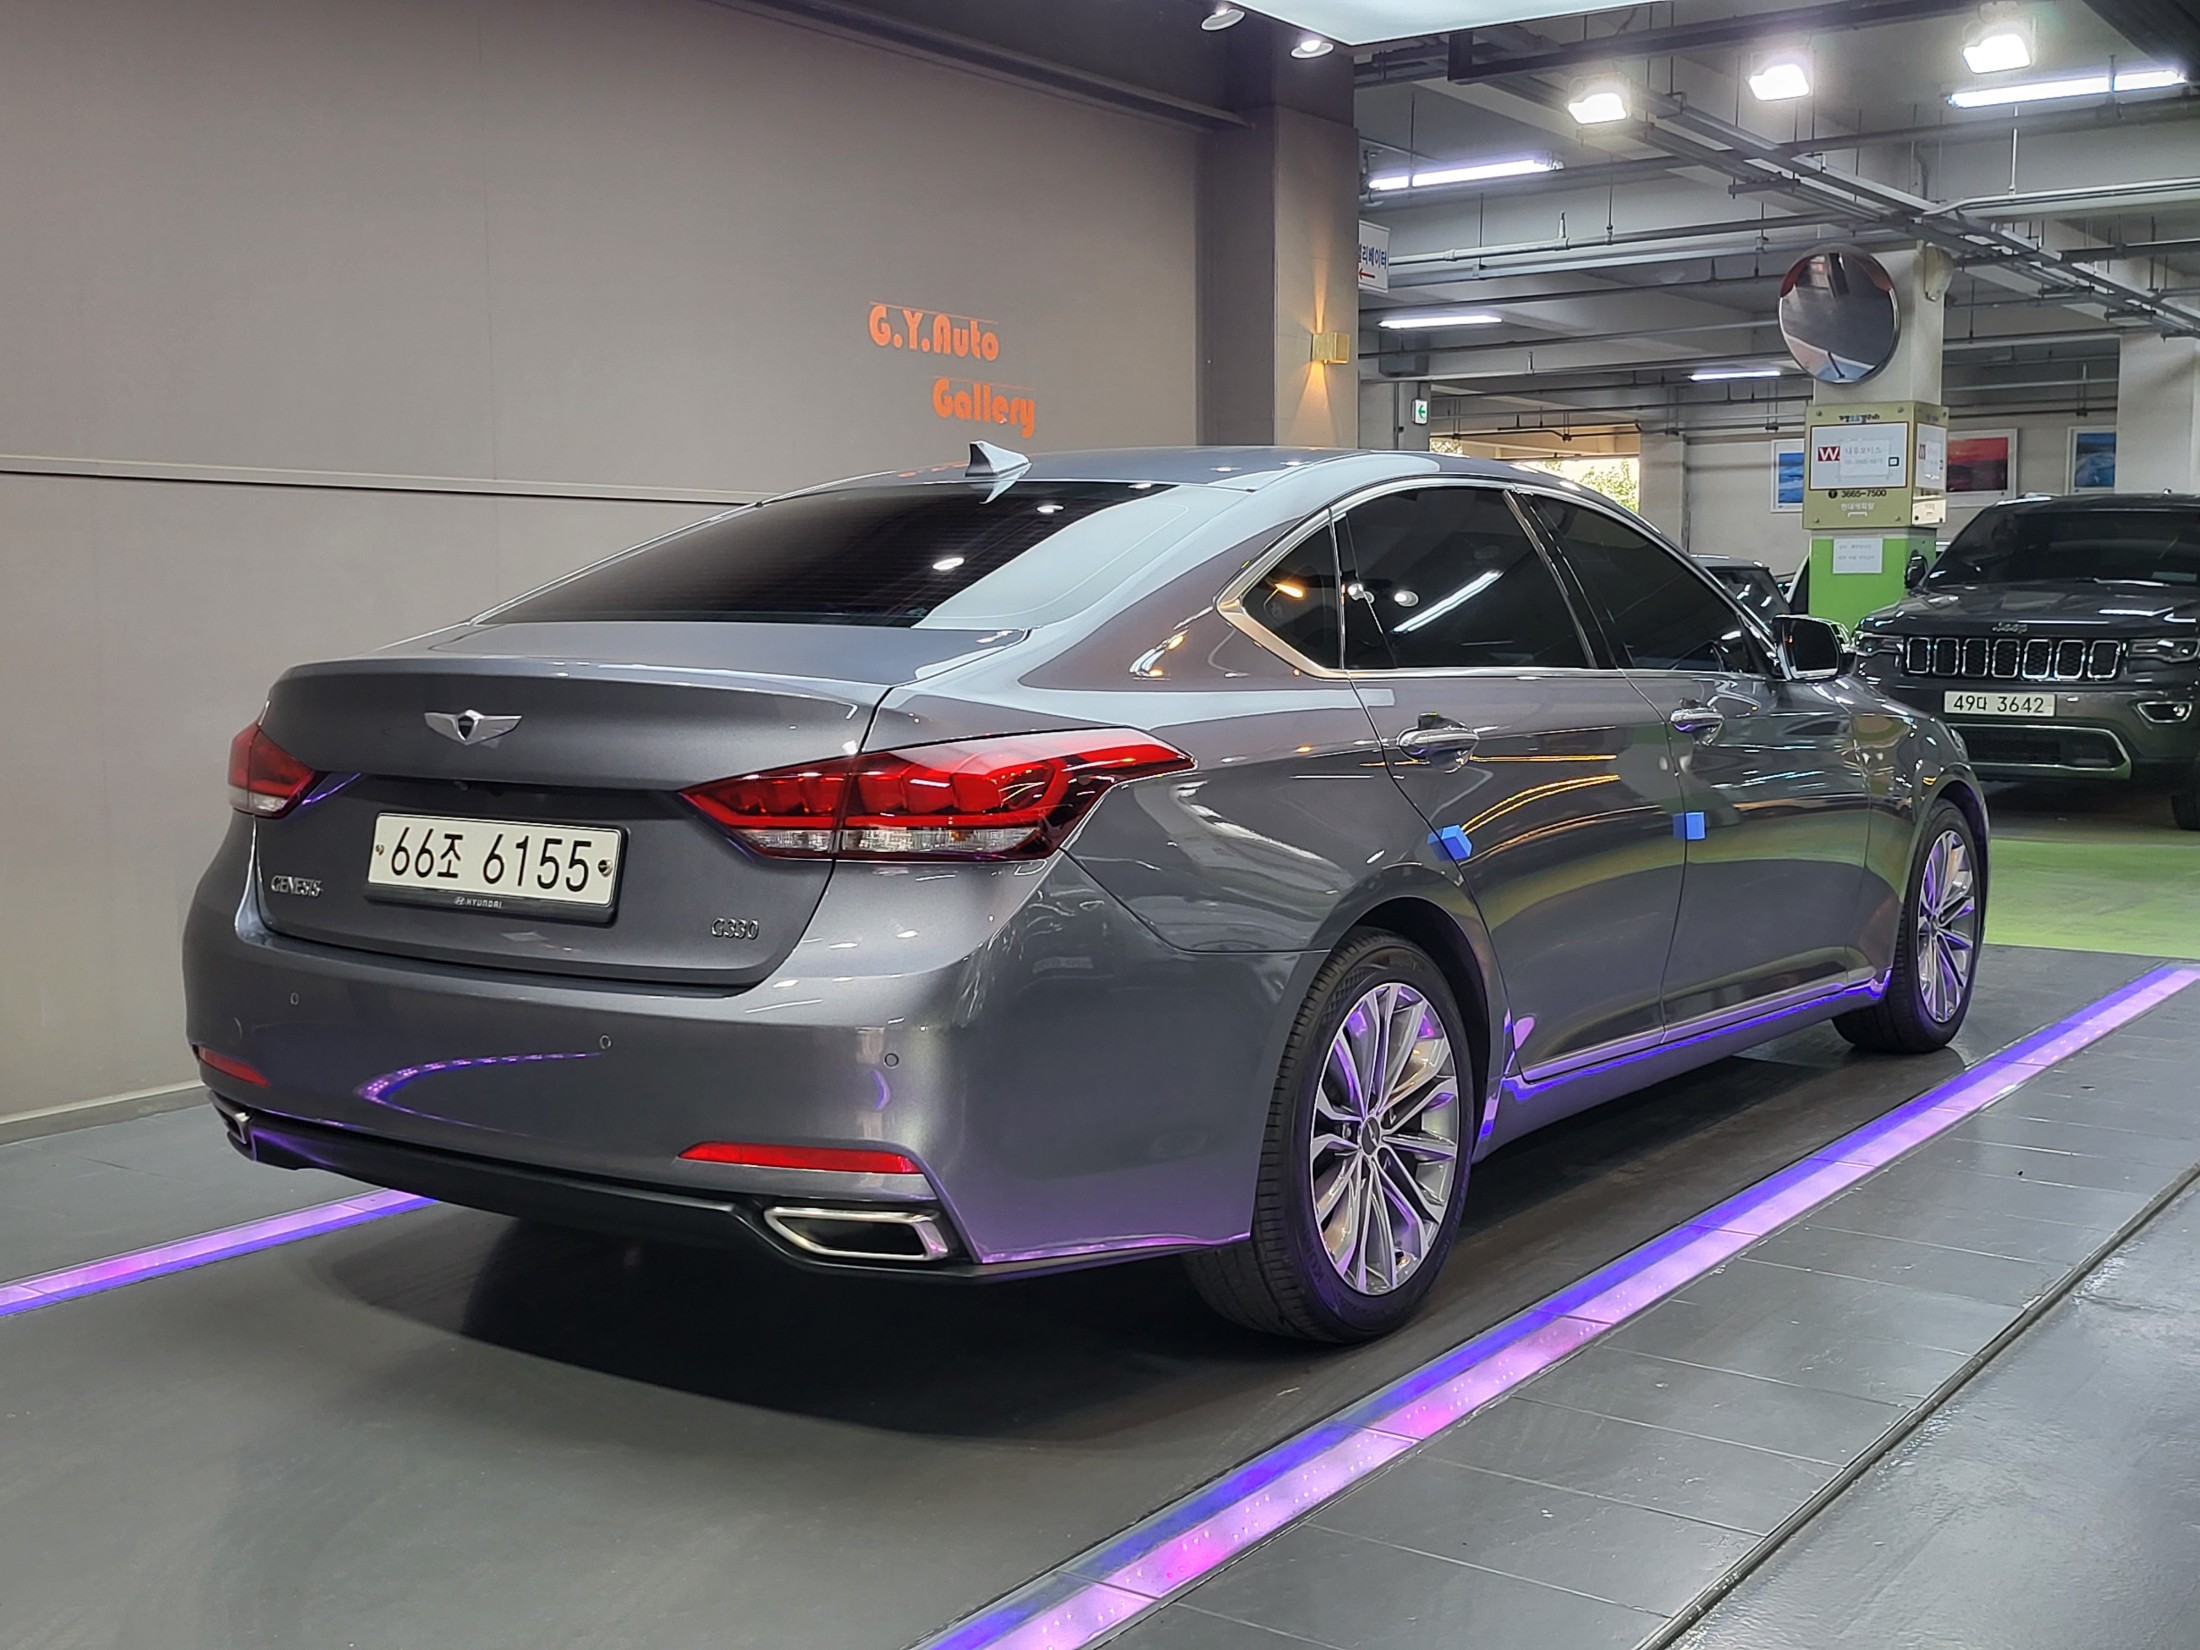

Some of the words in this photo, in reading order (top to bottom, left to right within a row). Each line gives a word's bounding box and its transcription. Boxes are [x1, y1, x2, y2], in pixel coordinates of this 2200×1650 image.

[868, 304, 999, 361] G.Y.Auto
[932, 377, 1036, 438] Gallery
[1841, 489, 1887, 498] 3665-7500
[1953, 694, 1988, 711] 49다
[1996, 696, 2045, 713] 3642
[391, 826, 464, 878] 66조
[483, 833, 593, 892] 6155
[270, 874, 322, 897] GENESIS
[466, 897, 503, 909] HYUNDAI
[711, 917, 760, 940] G330
